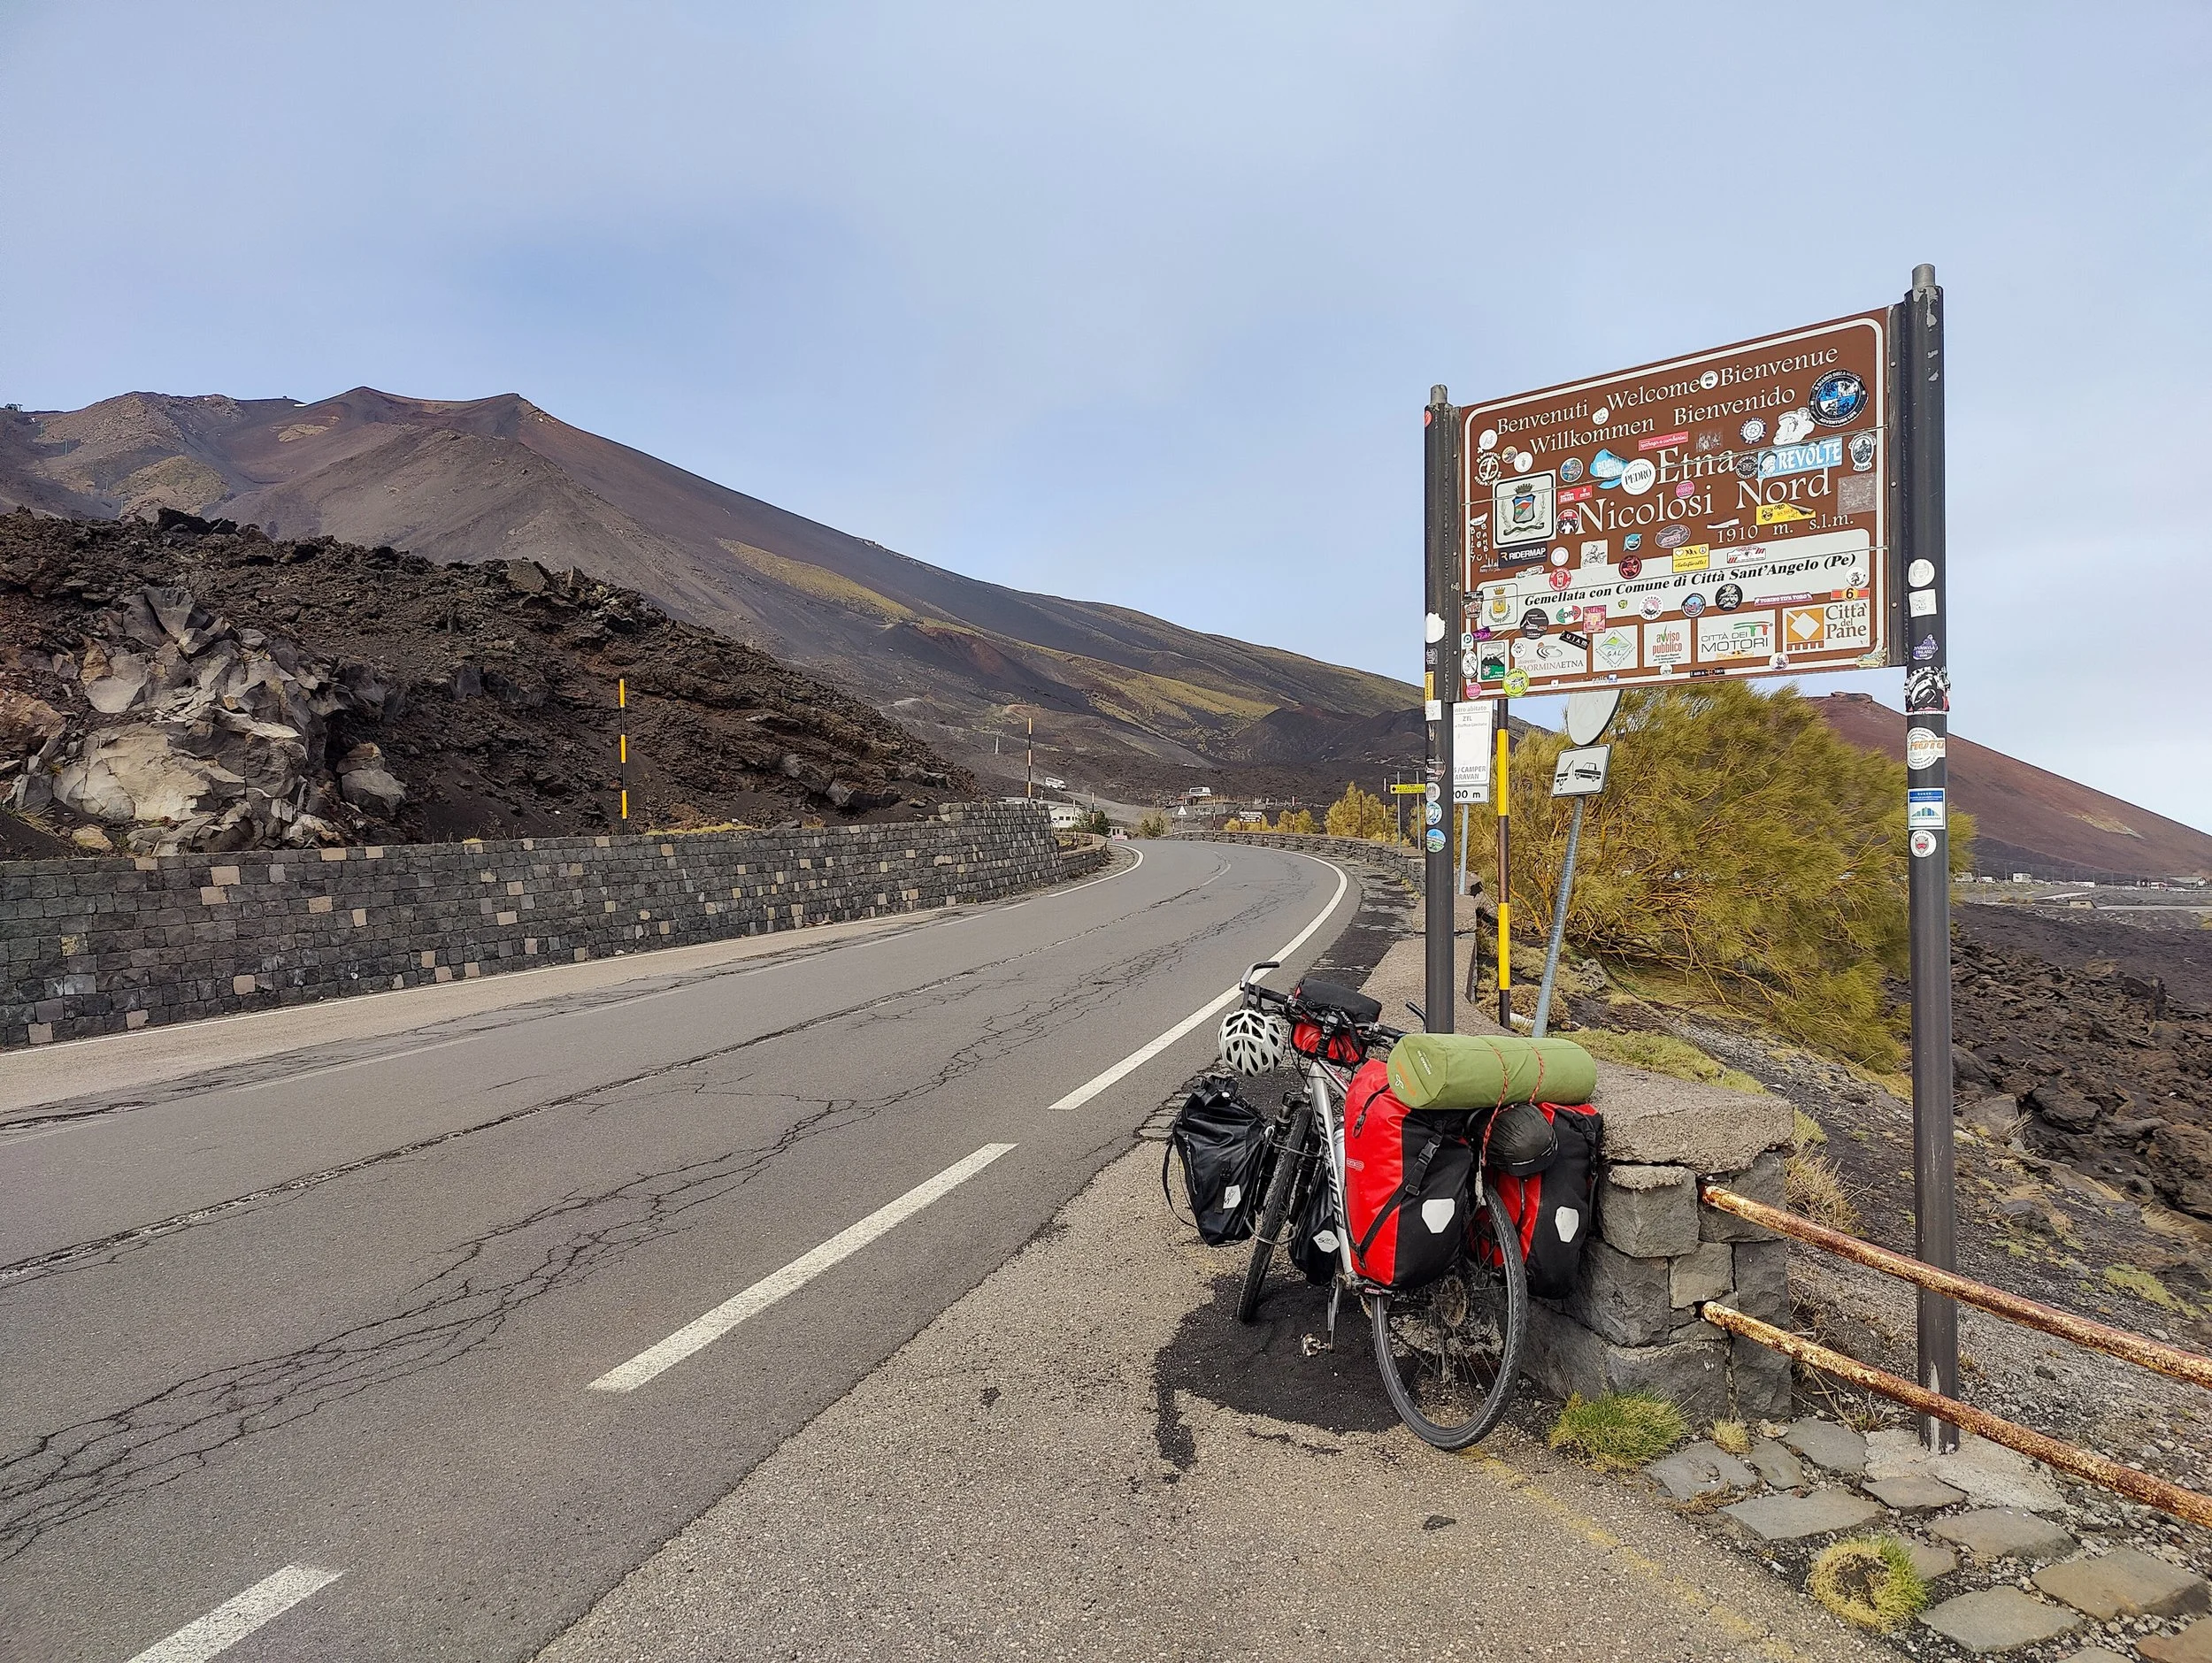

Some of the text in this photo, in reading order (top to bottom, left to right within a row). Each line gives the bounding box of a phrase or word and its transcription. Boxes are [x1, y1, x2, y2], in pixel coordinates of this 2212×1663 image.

[1497, 347, 1839, 435] Benvenuti Welcome Bienvenue
[1530, 384, 1795, 456] Willkommen Bienvenido
[1656, 446, 1737, 485] Etna
[1624, 468, 1652, 486] PEDRO
[1576, 468, 1832, 535] Nicolosi Nord
[1717, 525, 1759, 544] 1910
[1772, 522, 1793, 536] m.
[1809, 511, 1855, 531] s.l.m.
[1509, 548, 1547, 560] RIDERMAP
[1525, 553, 1856, 607] Gemellata con Comune di Città Sant'Angelo (Pe)
[1846, 587, 1854, 600] 6
[1558, 610, 1578, 619] SORA
[1825, 602, 1868, 620] Città
[1840, 617, 1854, 627] del
[1656, 629, 1680, 643] avviso
[1701, 631, 1747, 642] CITTÀ DEI
[1825, 624, 1867, 640] Pane
[1652, 641, 1683, 655] pubblico
[1701, 637, 1769, 653] MOTORI
[1455, 790, 1469, 799] 00
[1316, 1110, 1346, 1230] MERIDA
